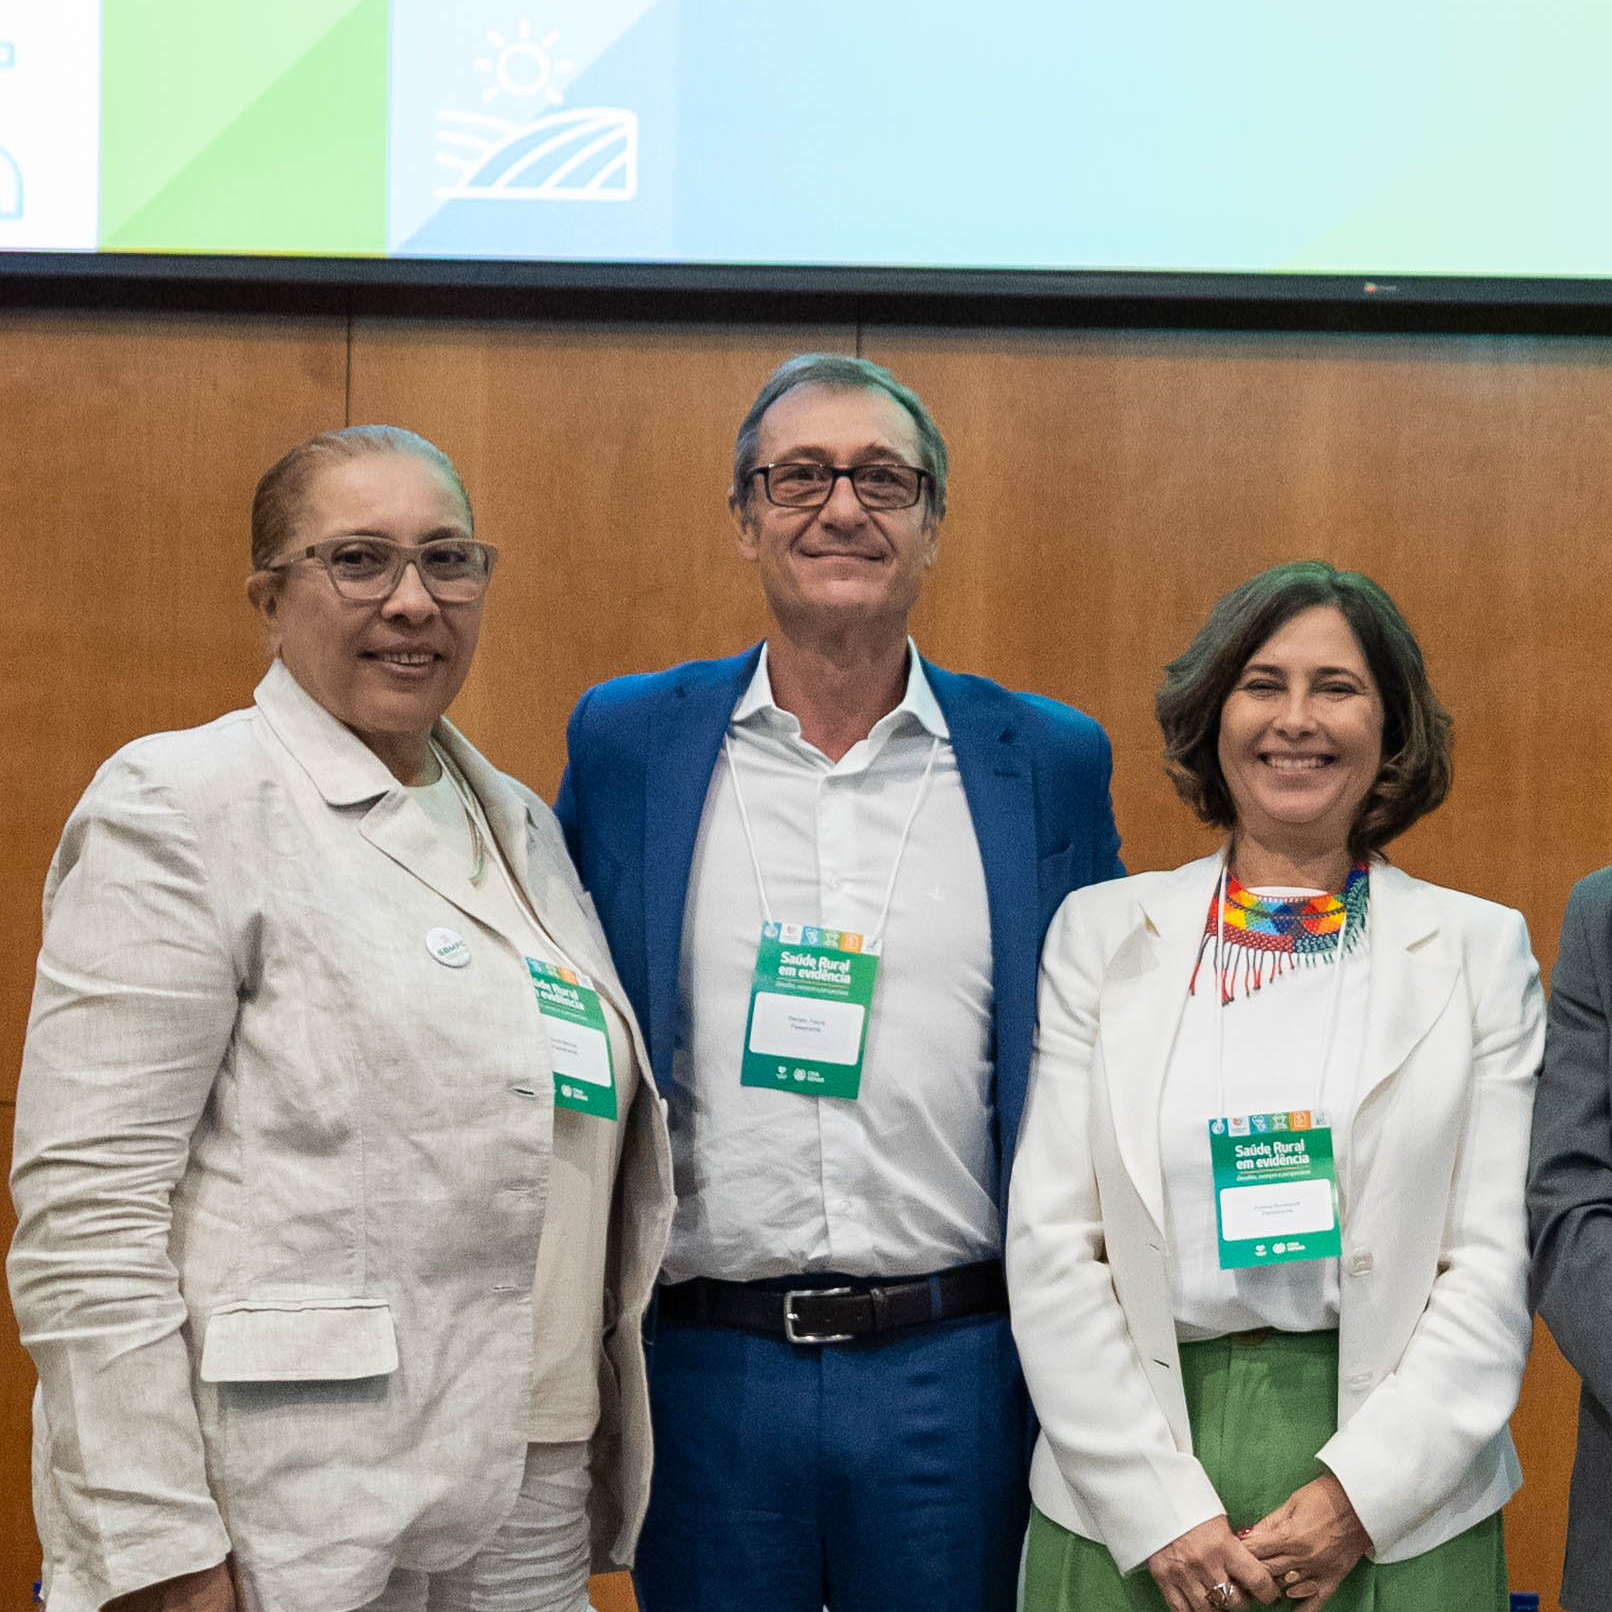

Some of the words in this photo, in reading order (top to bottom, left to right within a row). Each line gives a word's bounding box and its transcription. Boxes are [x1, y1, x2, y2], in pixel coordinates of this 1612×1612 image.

[780, 950, 817, 968] Saúde
[818, 956, 851, 972] Rural
[778, 966, 797, 977] em
[798, 967, 852, 984] evidência
[1234, 1142, 1272, 1158] Saúde
[1272, 1137, 1305, 1154] Rural
[1235, 1158, 1255, 1170] em
[1255, 1151, 1311, 1168] evidência
